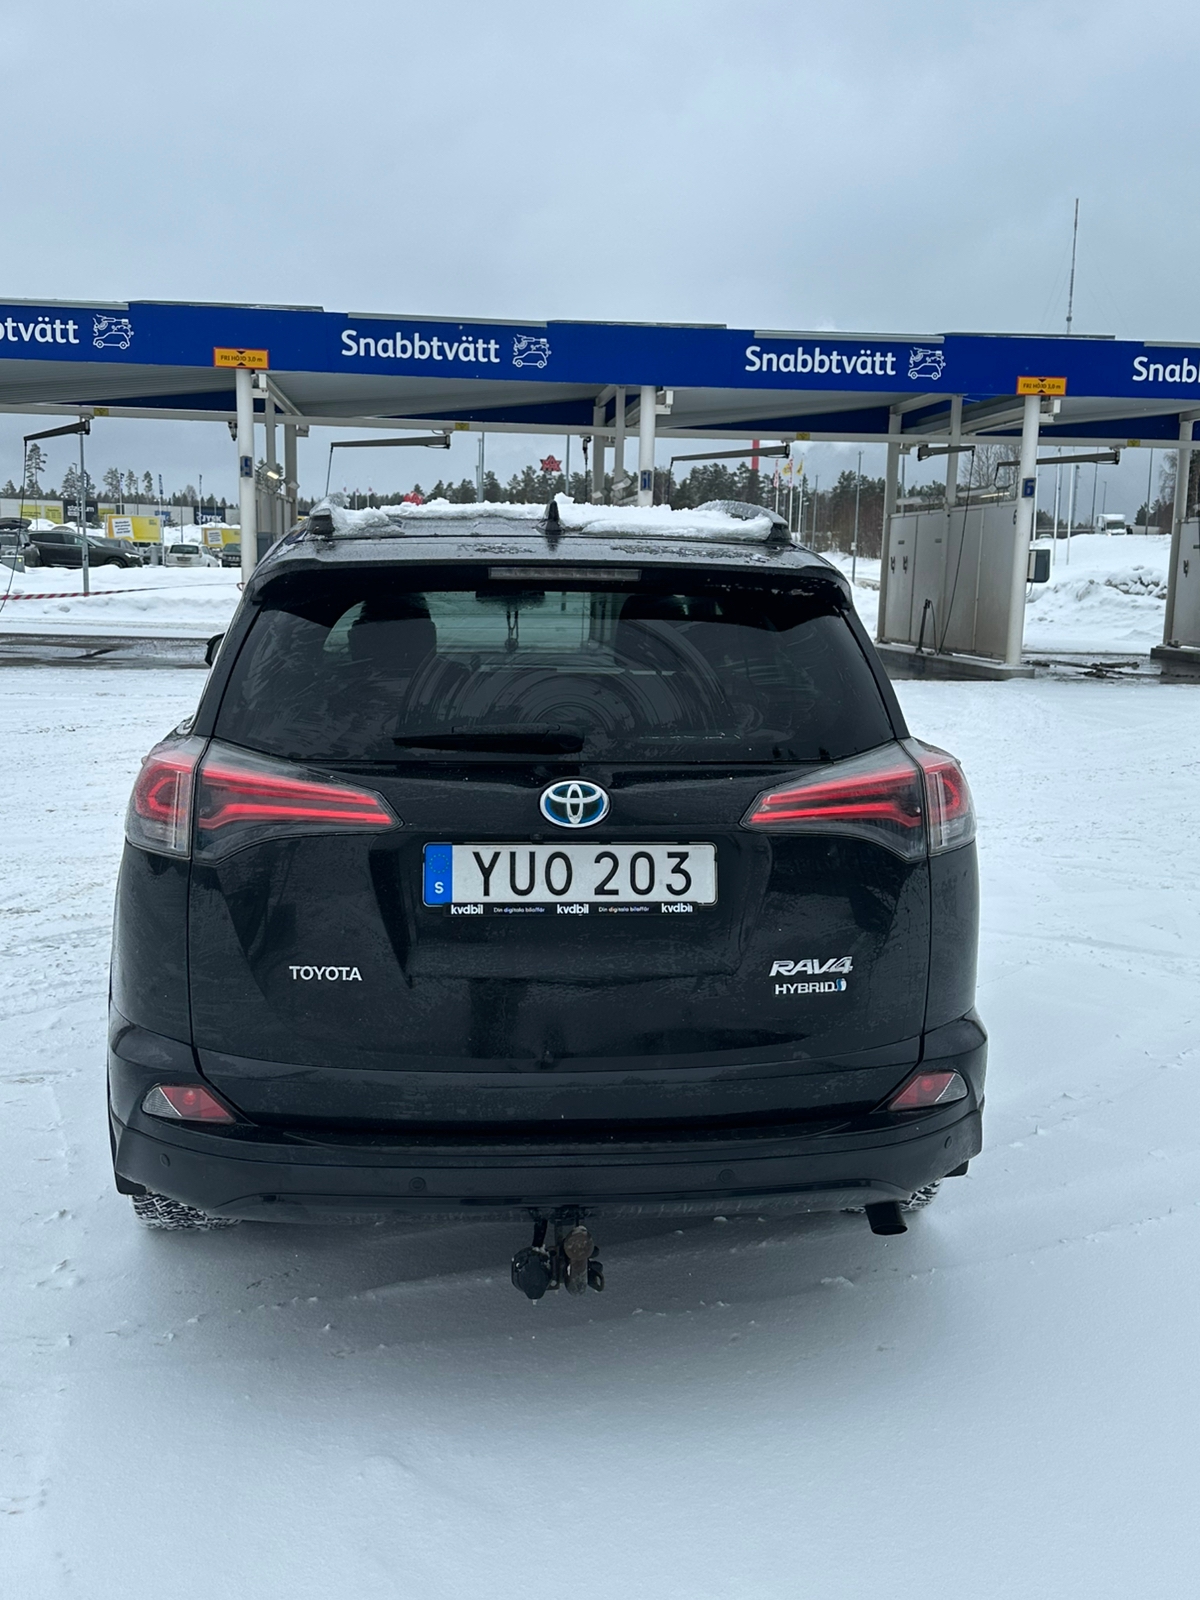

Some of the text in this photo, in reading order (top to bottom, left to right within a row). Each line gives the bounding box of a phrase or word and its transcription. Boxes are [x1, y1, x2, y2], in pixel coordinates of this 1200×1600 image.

[341, 326, 500, 364] Snabbtvätt
[745, 345, 897, 377] Snabbtvätt
[202, 514, 222, 523] JYSK
[472, 850, 692, 897] YUO 203
[434, 881, 444, 894] S
[450, 904, 484, 915] kvdbil
[556, 903, 589, 914] kvdbil
[289, 965, 363, 981] TOYOTA
[769, 956, 854, 977] RAV4
[775, 980, 836, 995] HYBRID
